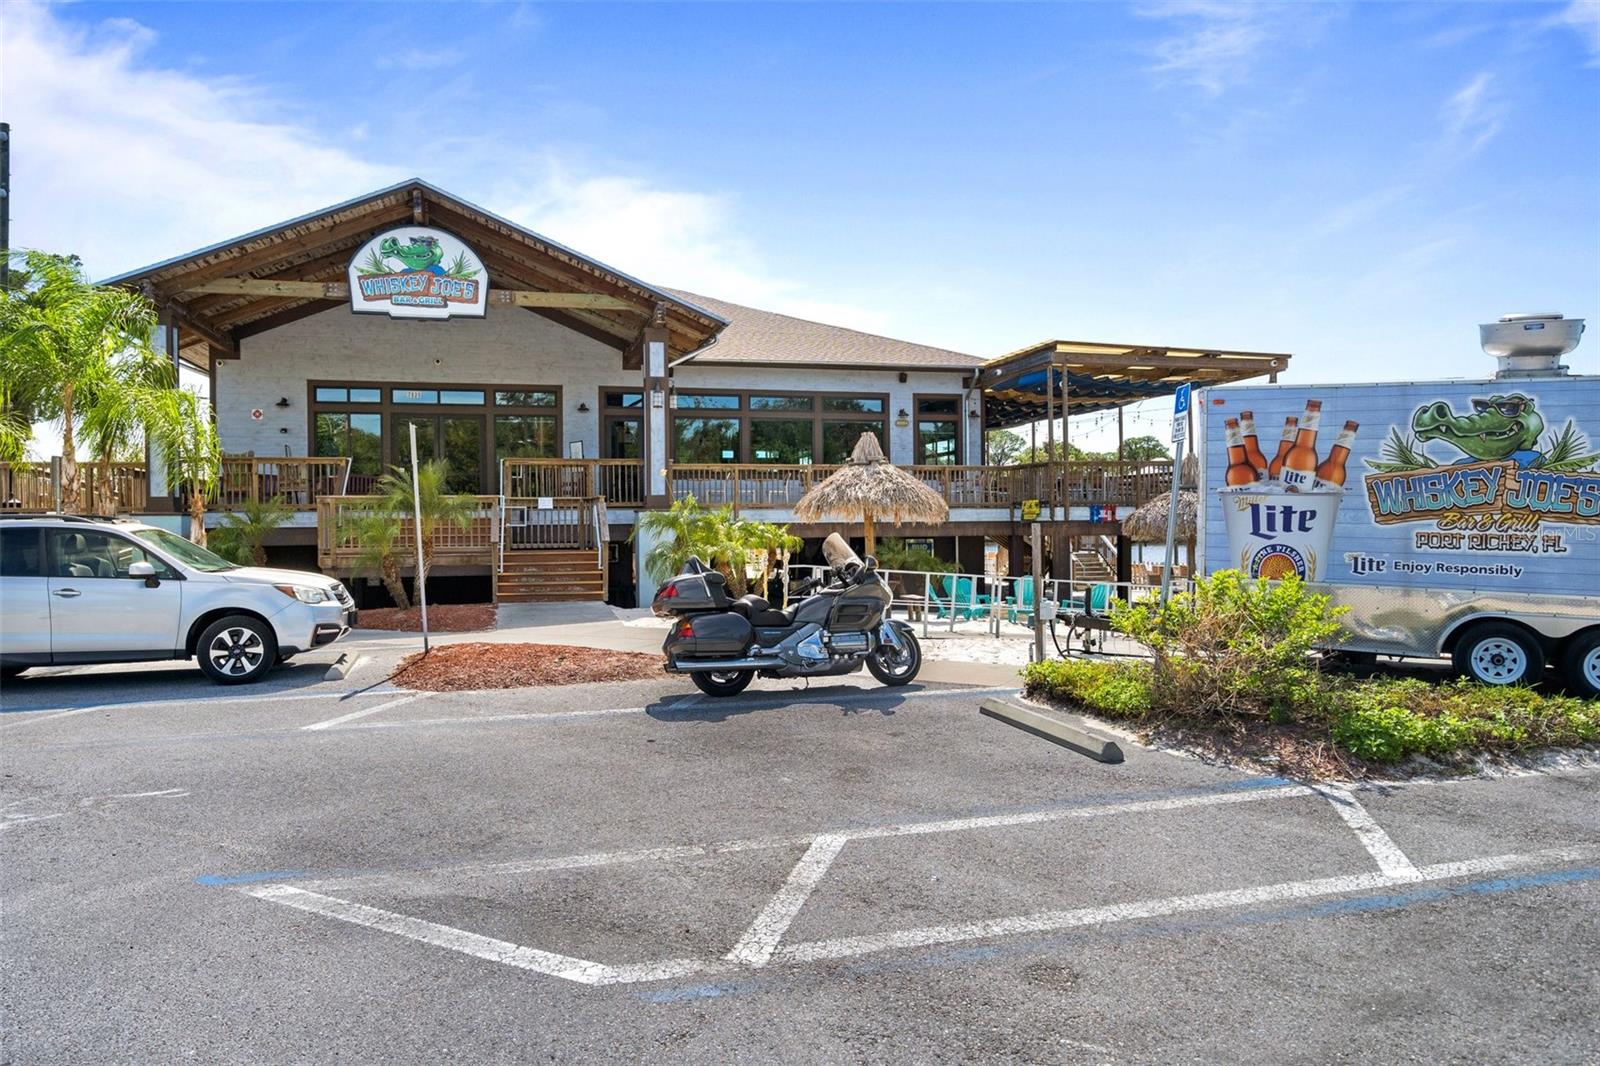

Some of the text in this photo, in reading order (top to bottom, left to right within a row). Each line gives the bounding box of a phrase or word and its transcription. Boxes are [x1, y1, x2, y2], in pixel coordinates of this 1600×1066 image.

[361, 275, 475, 299] WHISKEY JOE'S
[392, 296, 411, 304] BAR
[419, 297, 443, 305] GRILL
[1284, 470, 1307, 484] Lite
[1373, 467, 1600, 516] WHISKEY JOE'S
[1248, 503, 1318, 540] Lite
[1438, 513, 1539, 532] Bar & Grill
[1416, 533, 1567, 553] PORT RICHEY, FL
[1276, 545, 1305, 572] PILSNER
[1352, 556, 1386, 575] Lite
[1394, 561, 1522, 577] Enjoy Responsibly
